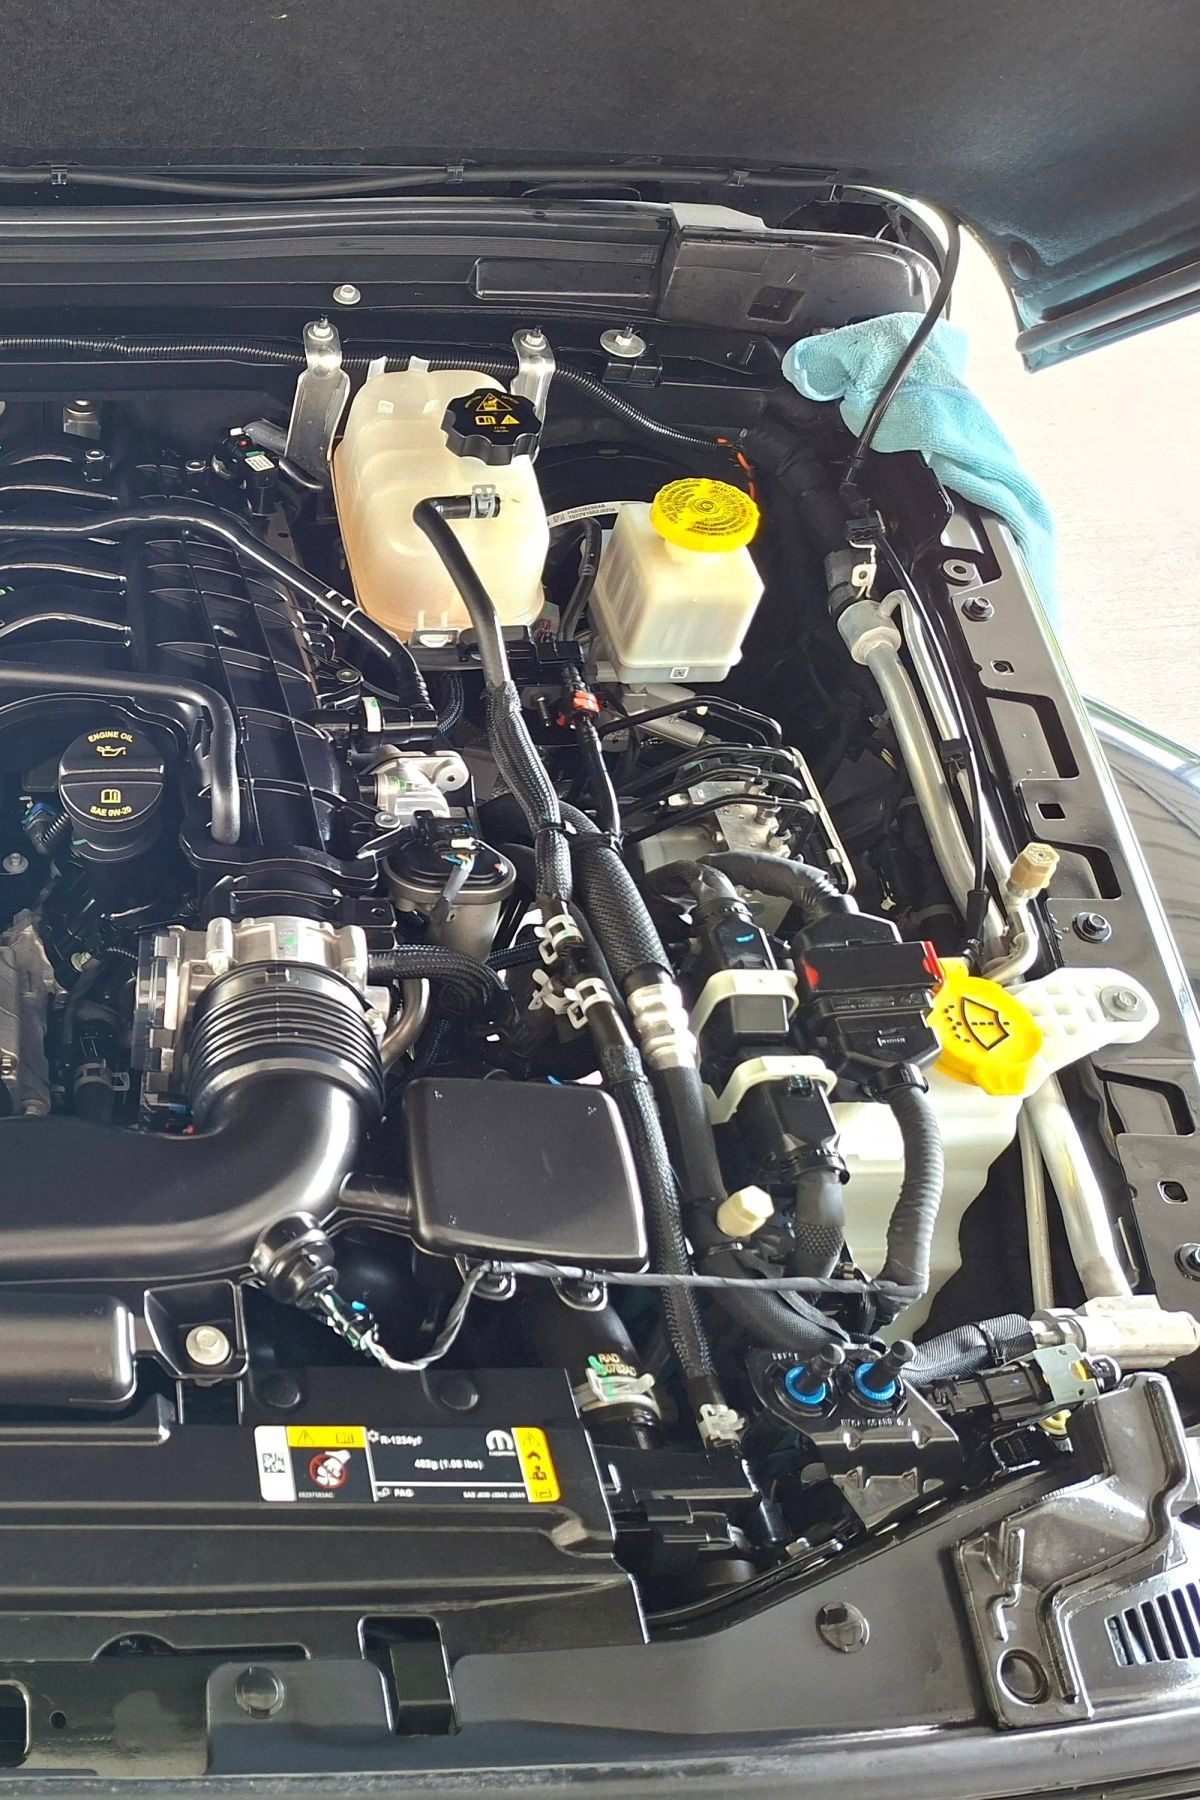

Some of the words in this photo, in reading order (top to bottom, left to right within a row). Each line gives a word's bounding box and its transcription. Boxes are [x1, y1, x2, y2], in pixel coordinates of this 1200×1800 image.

[88, 731, 118, 742] ENGINE
[120, 733, 133, 743] OIL
[90, 806, 107, 816] SAE
[108, 806, 132, 817] 0W-20
[597, 1353, 620, 1363] RAD
